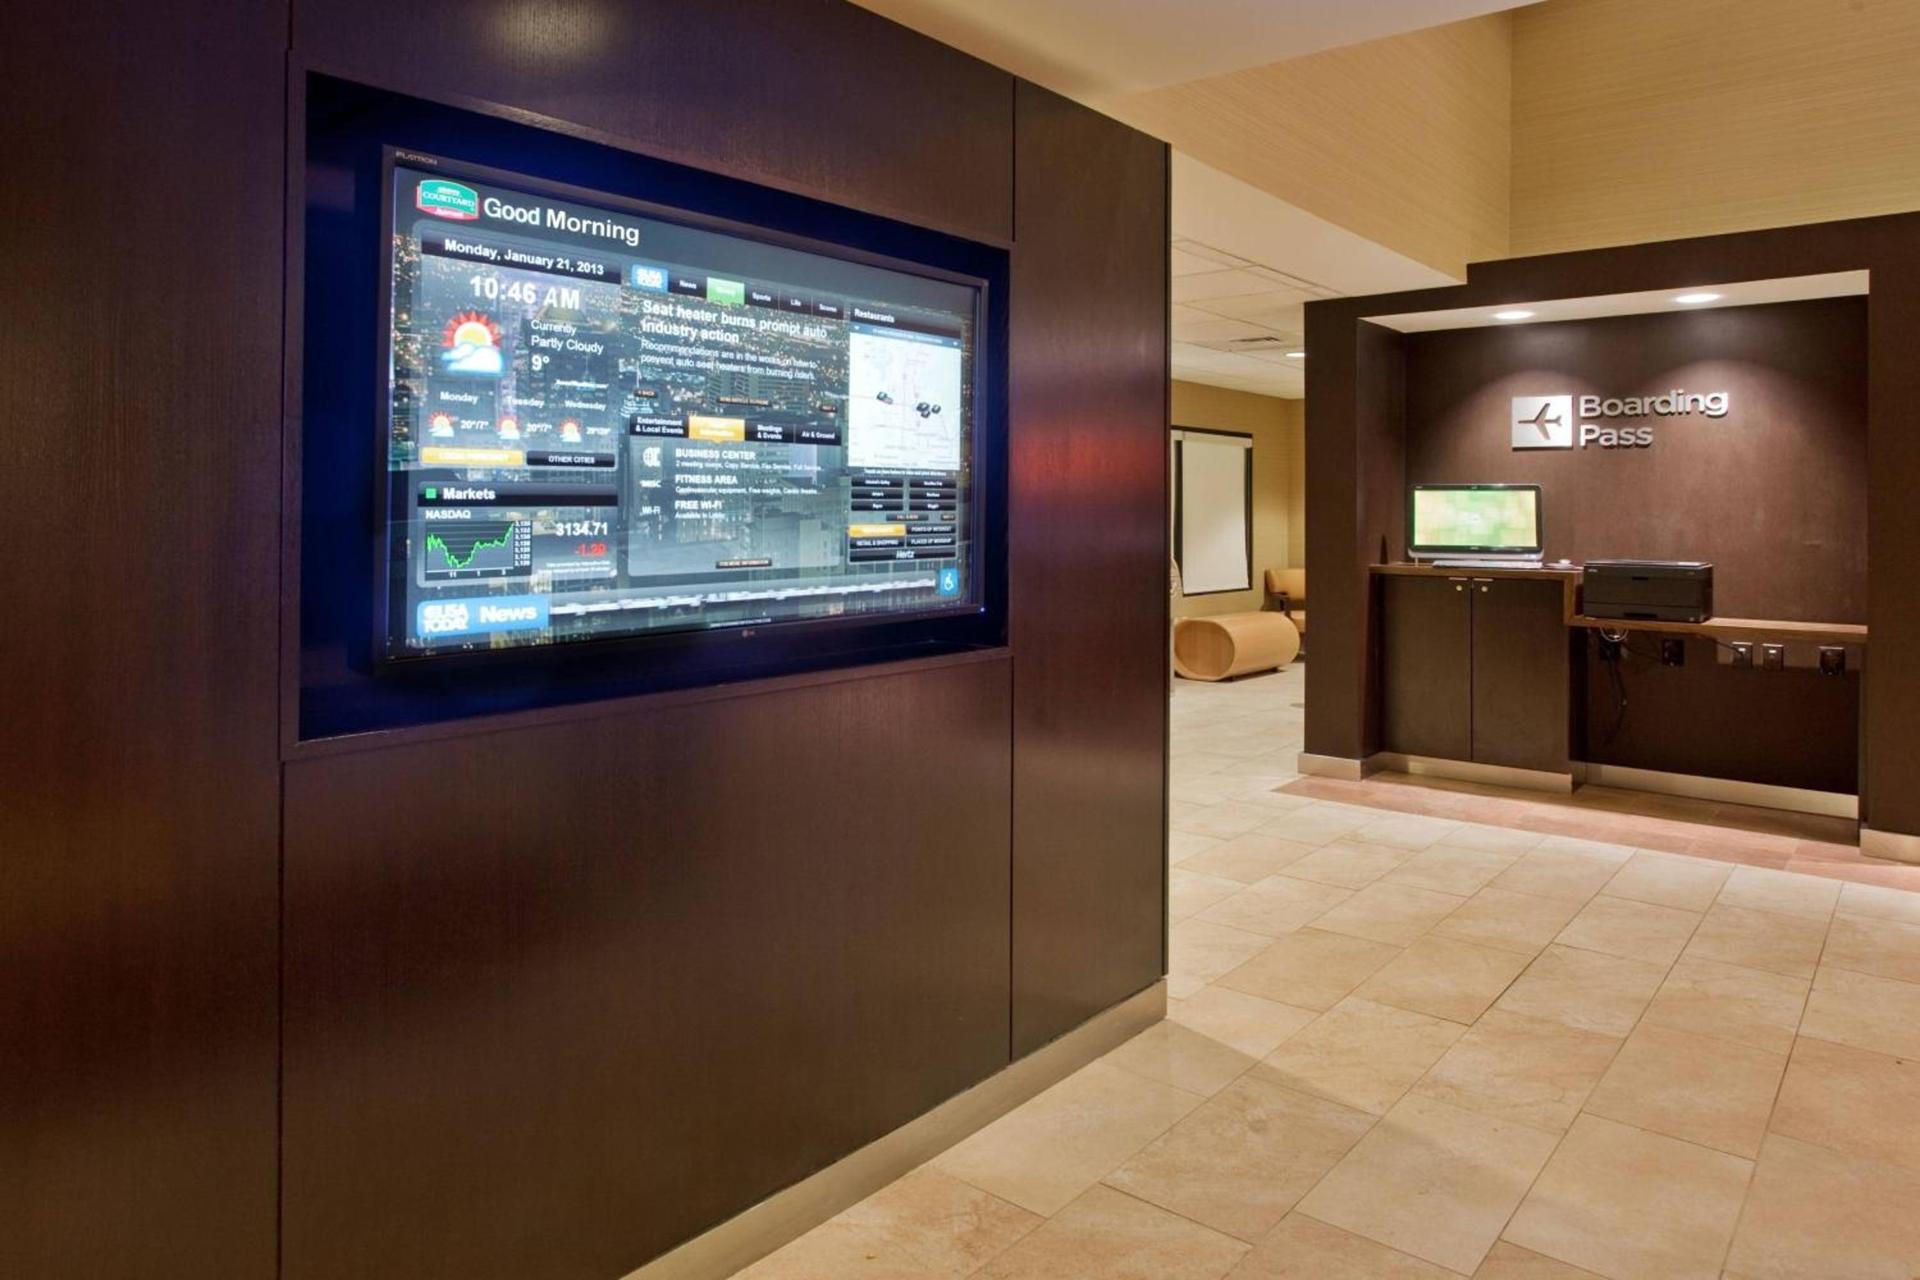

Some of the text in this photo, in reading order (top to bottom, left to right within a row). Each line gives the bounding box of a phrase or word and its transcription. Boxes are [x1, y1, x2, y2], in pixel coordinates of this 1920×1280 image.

[423, 191, 476, 208] COURTYARD
[484, 198, 640, 247] Good Morning
[445, 239, 604, 276] Monday, January 21, 2013
[470, 275, 581, 310] 10:46 AM
[642, 300, 828, 340] Seat heater burns prompt auto
[854, 308, 895, 323] Restaurants
[531, 320, 578, 336] Currently
[700, 329, 740, 345] action
[531, 336, 604, 355] Partly Cloudy
[440, 391, 479, 406] Monday
[506, 395, 545, 409] Tuesday
[565, 400, 608, 412] Wednesday
[1580, 389, 1729, 418] Boarding
[637, 416, 682, 428] Entertainment
[643, 426, 660, 434] Local
[662, 427, 684, 435] Events
[1580, 424, 1654, 448] Pass
[548, 455, 572, 463] OTHER
[675, 448, 757, 461] BUSINESS CENTER
[675, 474, 738, 485] FITNESS AREA
[443, 488, 496, 501] Markets
[675, 500, 699, 510] FREE
[425, 510, 472, 520] NASDAQ
[556, 521, 608, 537] 3134.71
[479, 605, 538, 624] News
